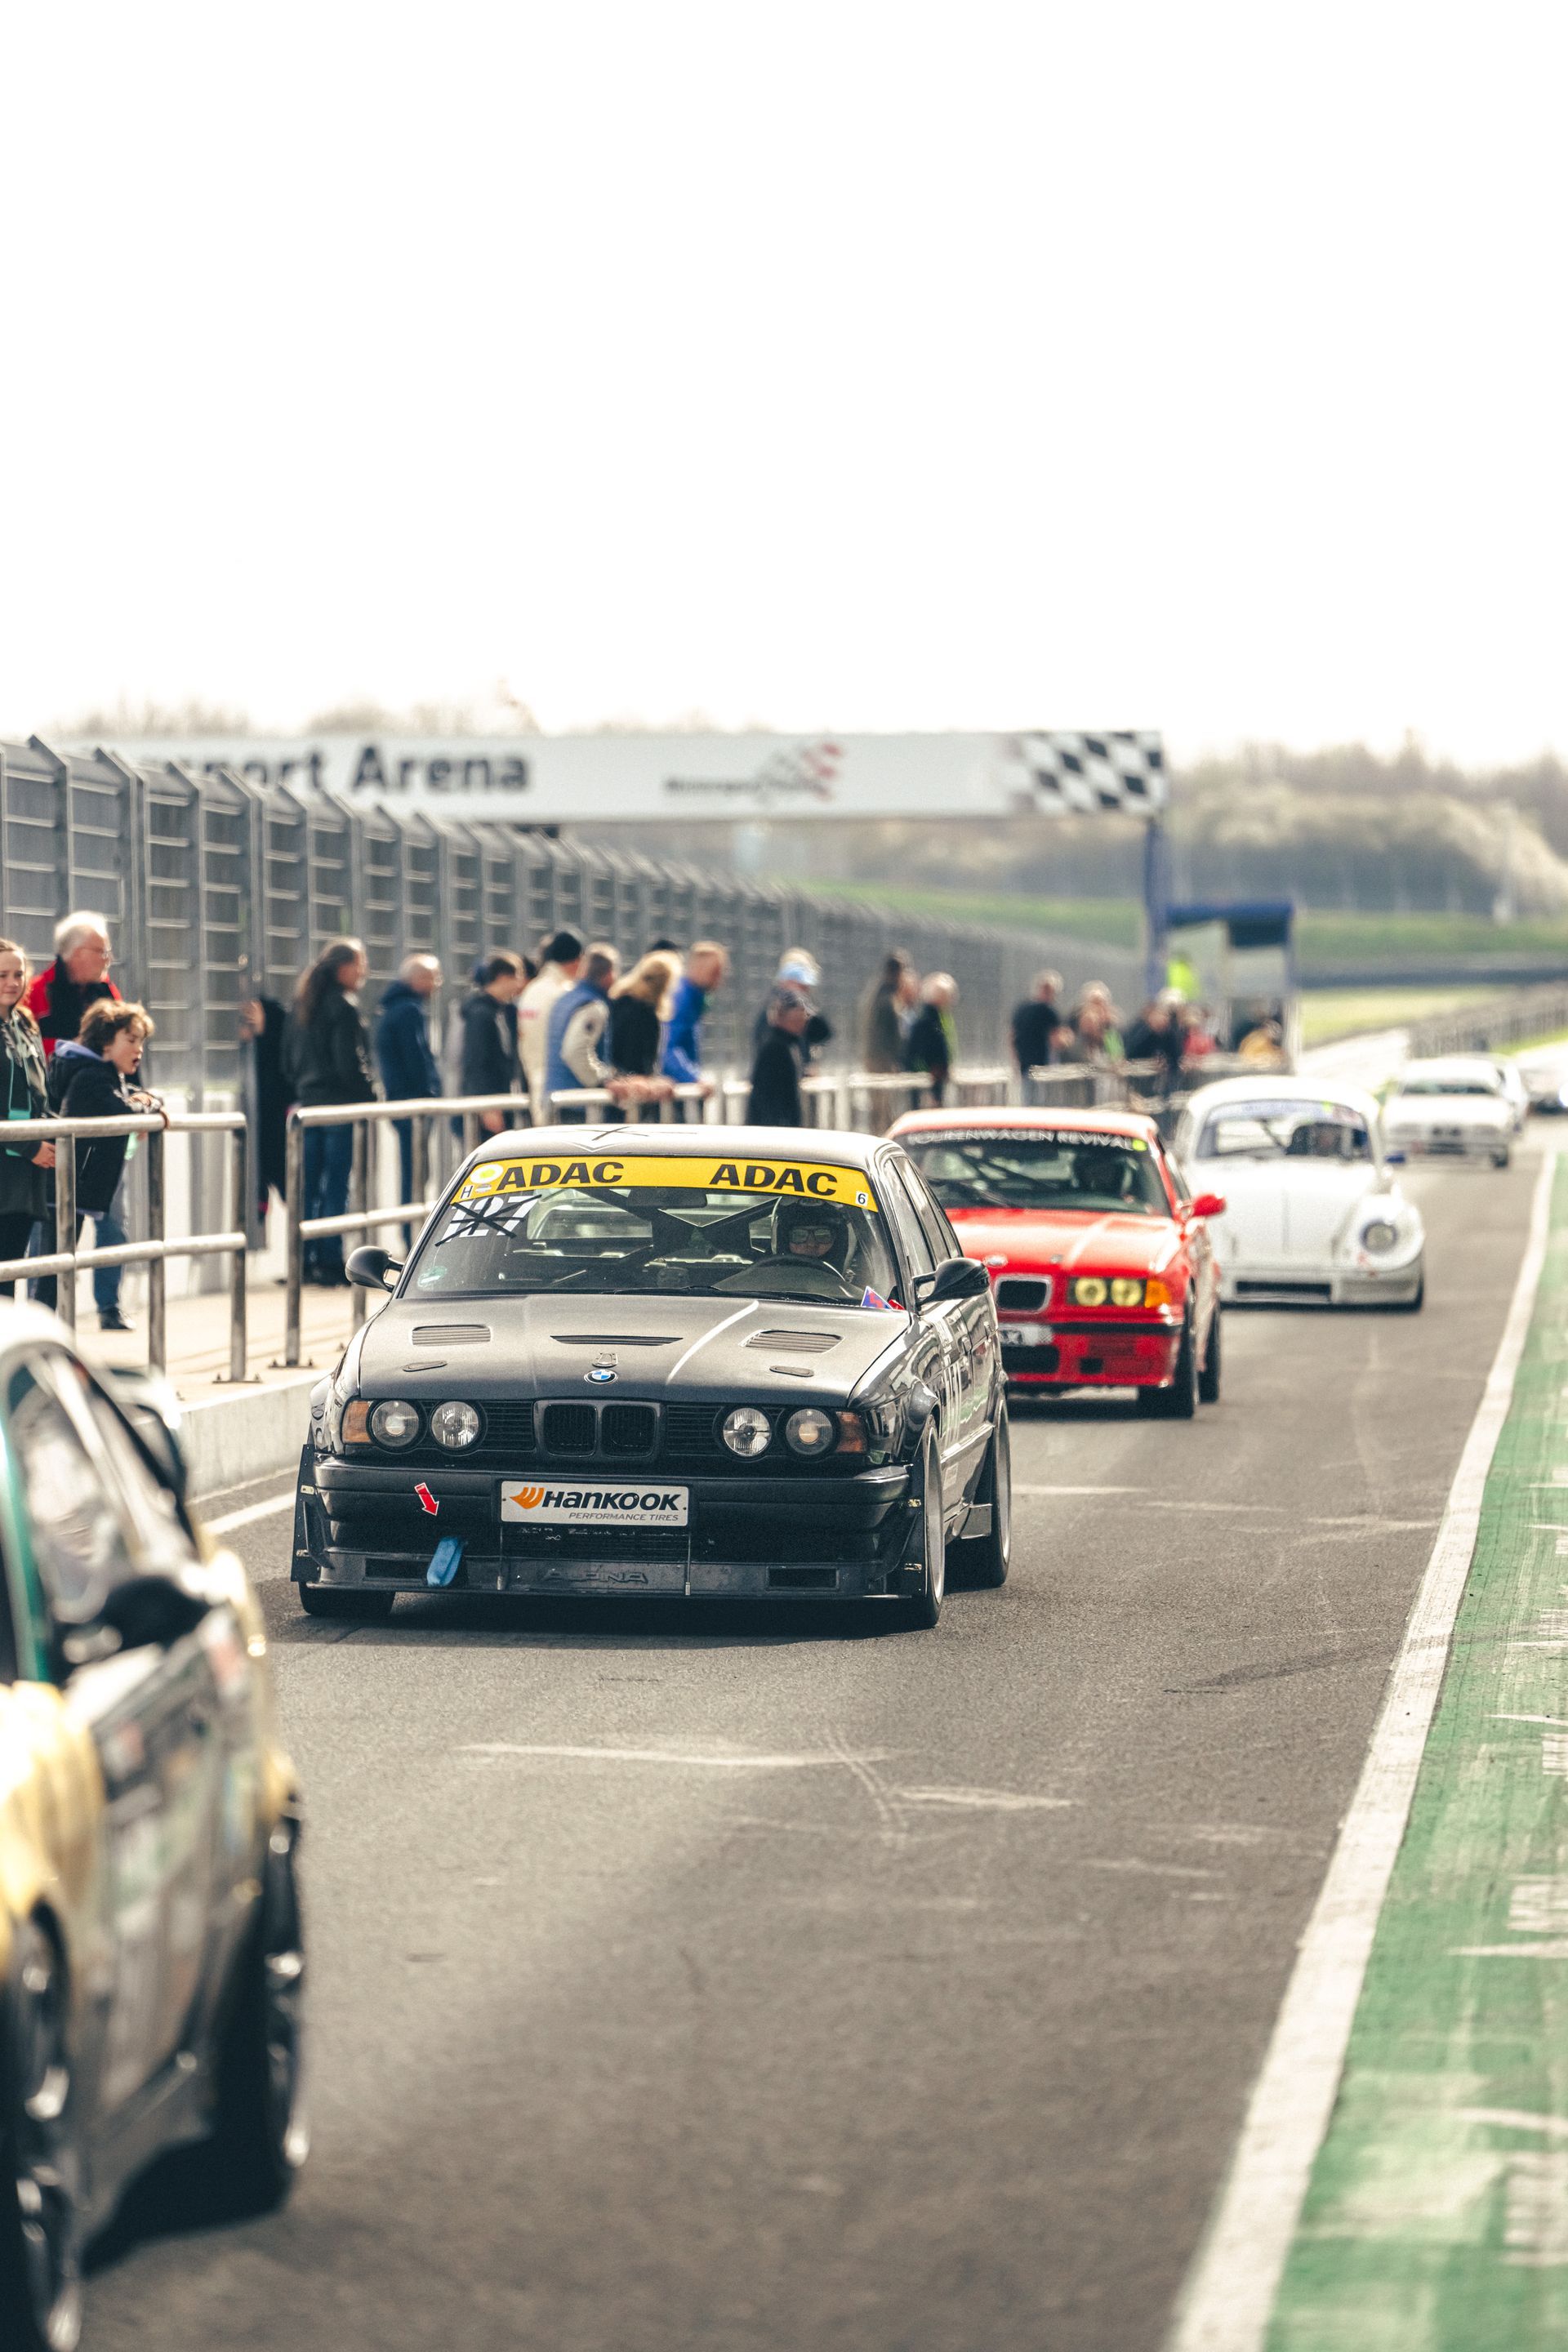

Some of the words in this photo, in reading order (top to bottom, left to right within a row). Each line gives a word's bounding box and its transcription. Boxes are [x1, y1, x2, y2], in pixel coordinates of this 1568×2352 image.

[351, 745, 529, 791] Arena
[496, 1161, 624, 1192] ADAC
[709, 1164, 838, 1196] ADAC
[857, 1192, 866, 1205] 6
[568, 1512, 646, 1521] PERFORMANCE
[649, 1513, 679, 1521] TIRES
